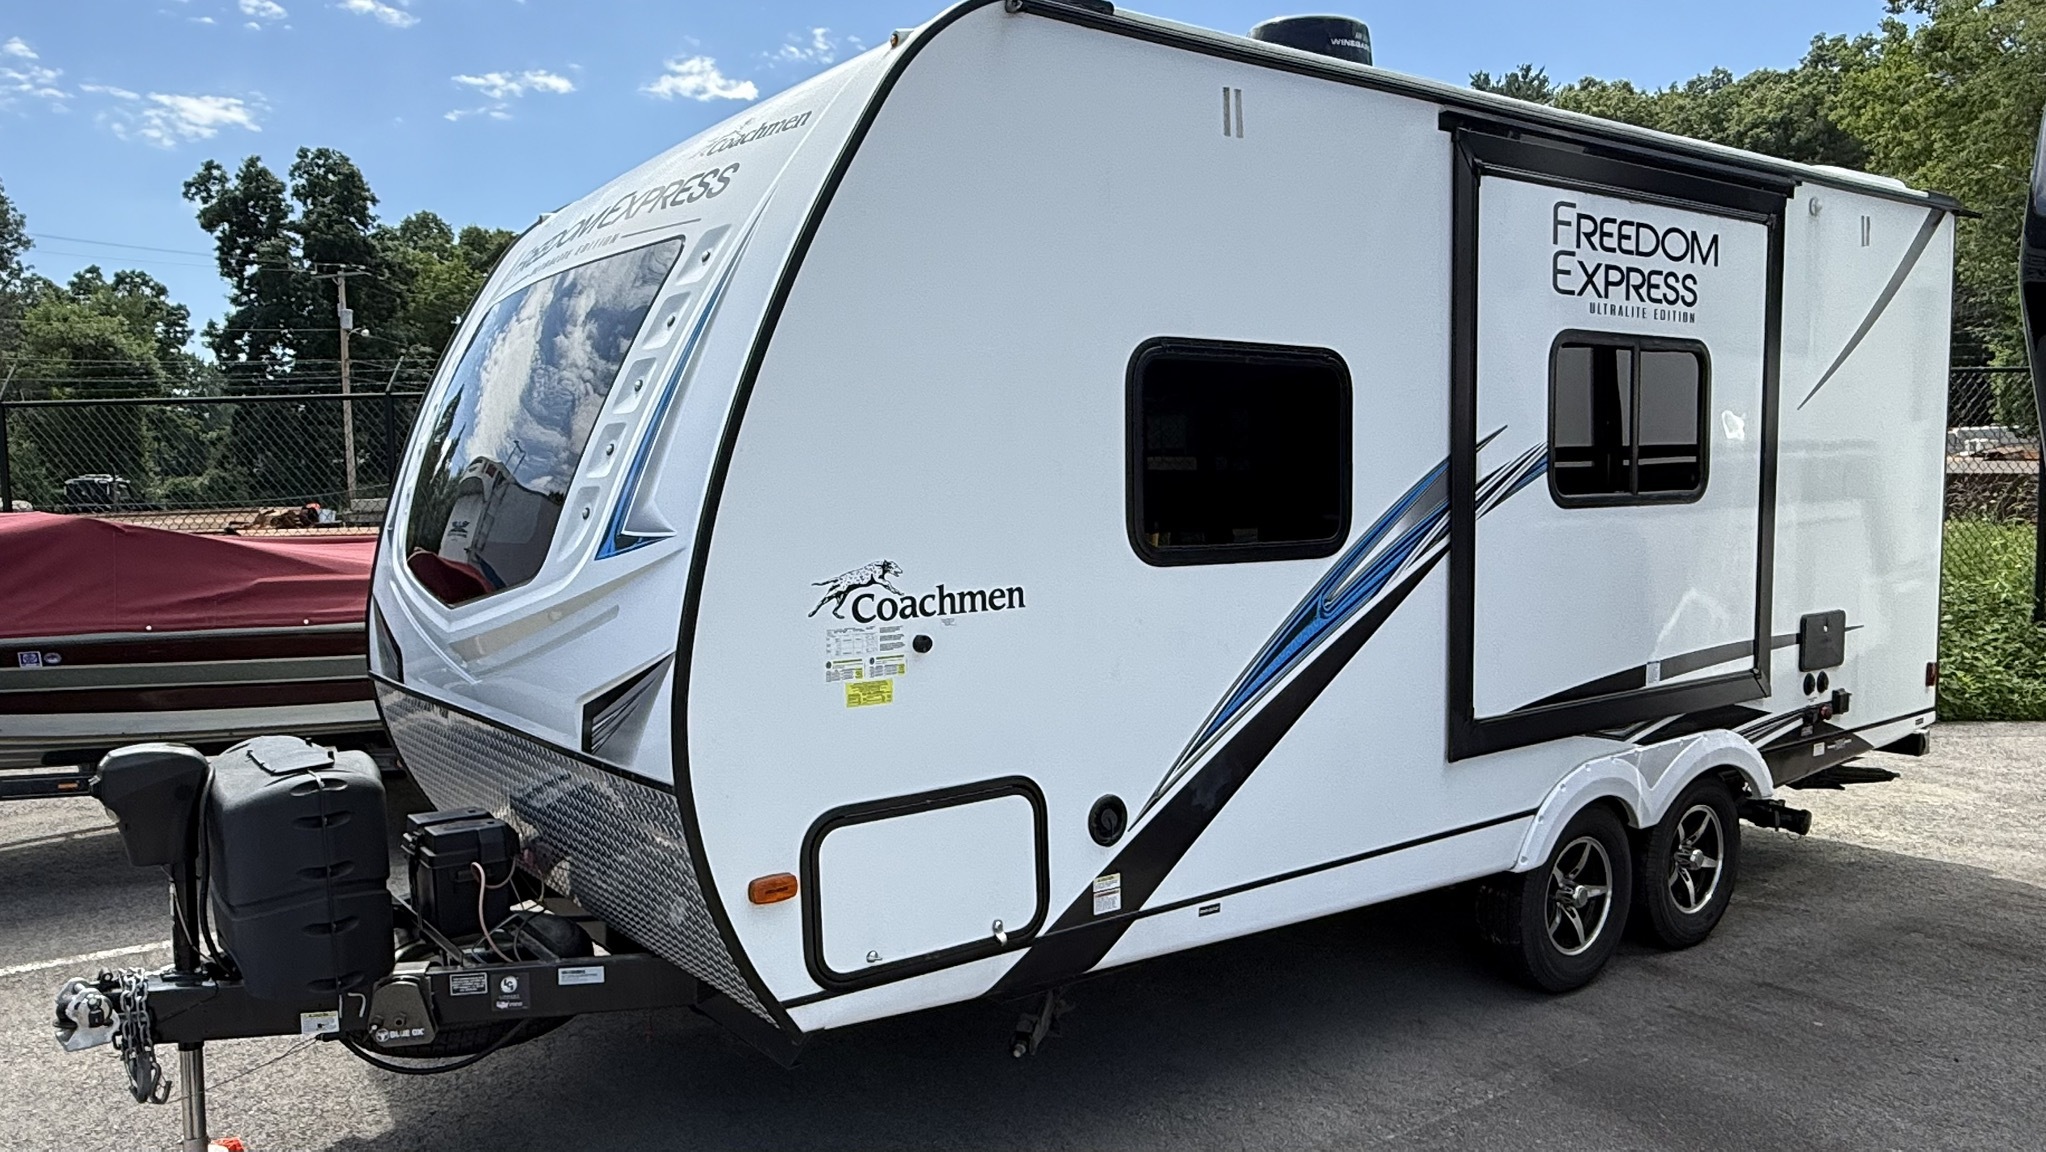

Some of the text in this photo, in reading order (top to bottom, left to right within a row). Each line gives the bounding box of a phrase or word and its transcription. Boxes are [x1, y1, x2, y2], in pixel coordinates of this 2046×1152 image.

[706, 110, 813, 157] Coachmen
[1552, 200, 1719, 268] FREEDOM
[1552, 249, 1698, 308] EXPRESS
[1589, 302, 1696, 324] ULTRALITE EDITION
[851, 583, 1026, 624] Coachmen
